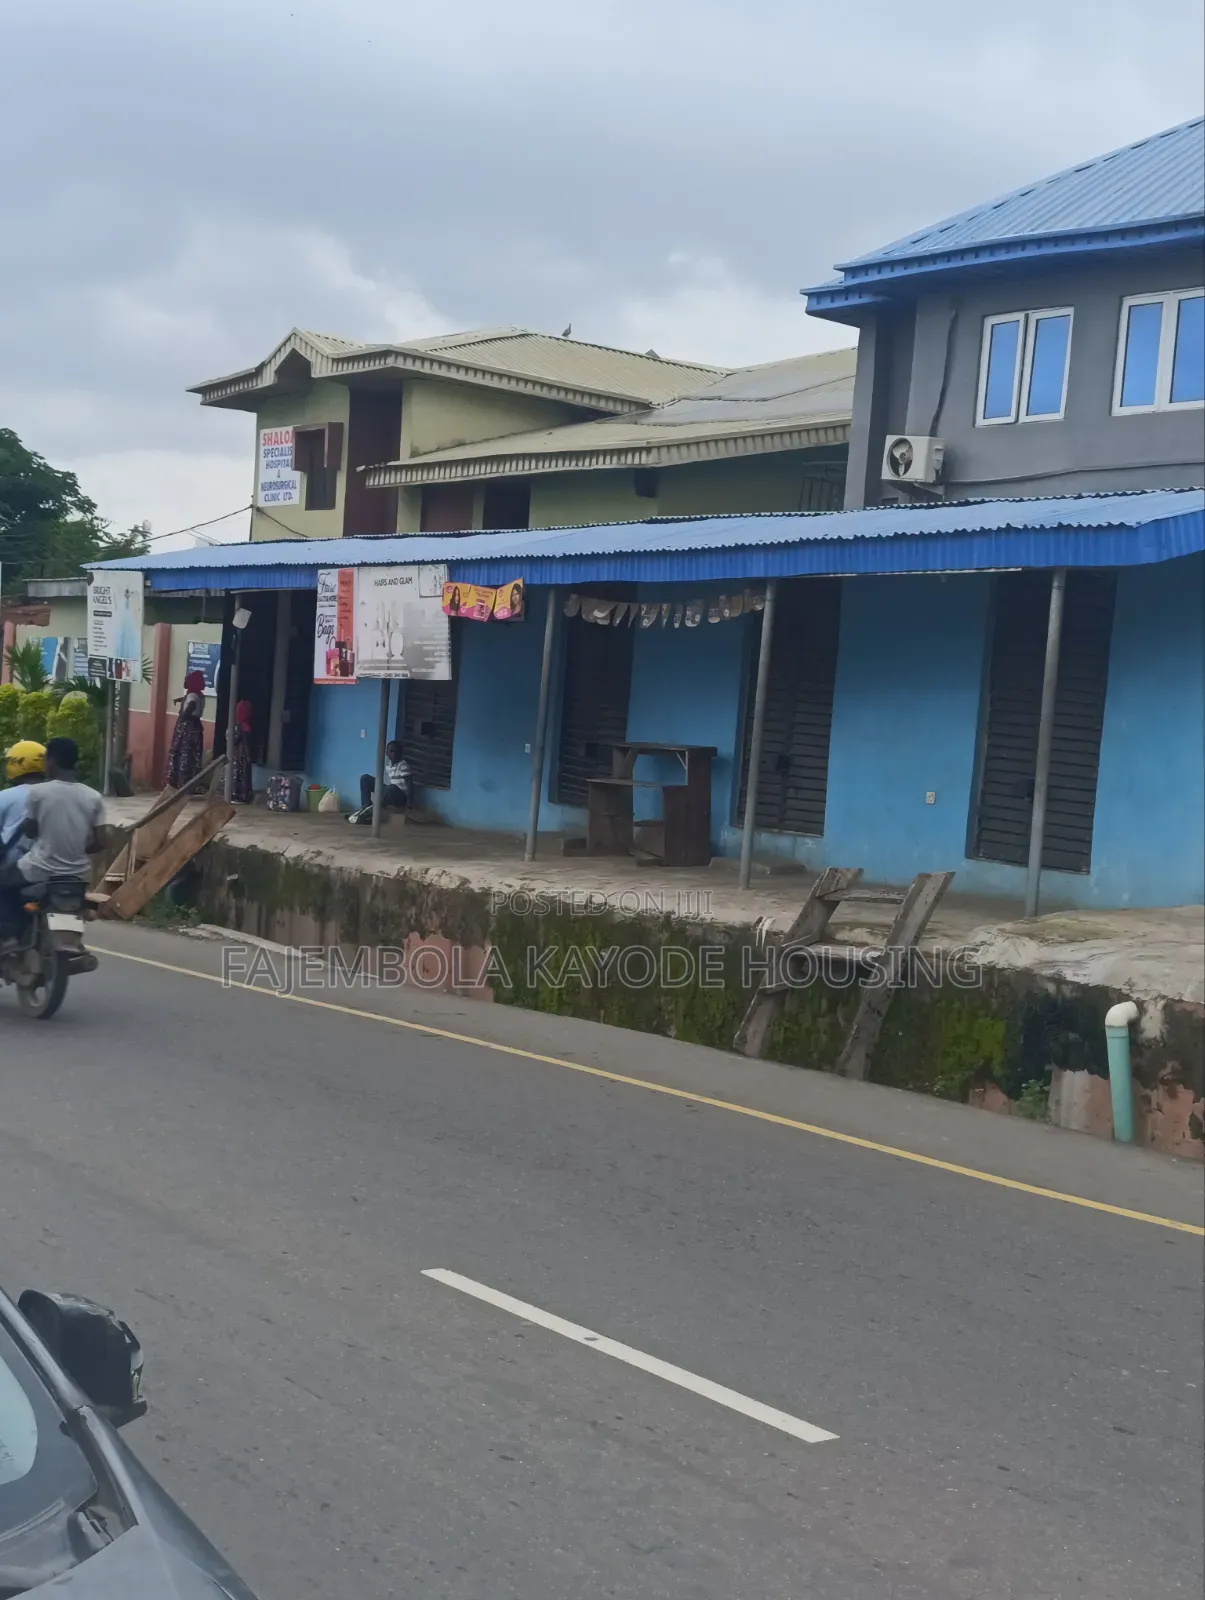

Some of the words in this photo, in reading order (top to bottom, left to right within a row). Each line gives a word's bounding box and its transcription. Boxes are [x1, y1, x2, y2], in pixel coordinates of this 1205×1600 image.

[263, 431, 293, 446] SHALO
[263, 446, 293, 458] SPECIALIS
[261, 480, 298, 492] NEUROSURGICAL
[264, 493, 281, 502] CLINIC
[374, 579, 387, 587] HAIRS
[399, 576, 413, 584] GLAM
[93, 586, 111, 595] BRIGHT
[316, 613, 335, 645] Bags
